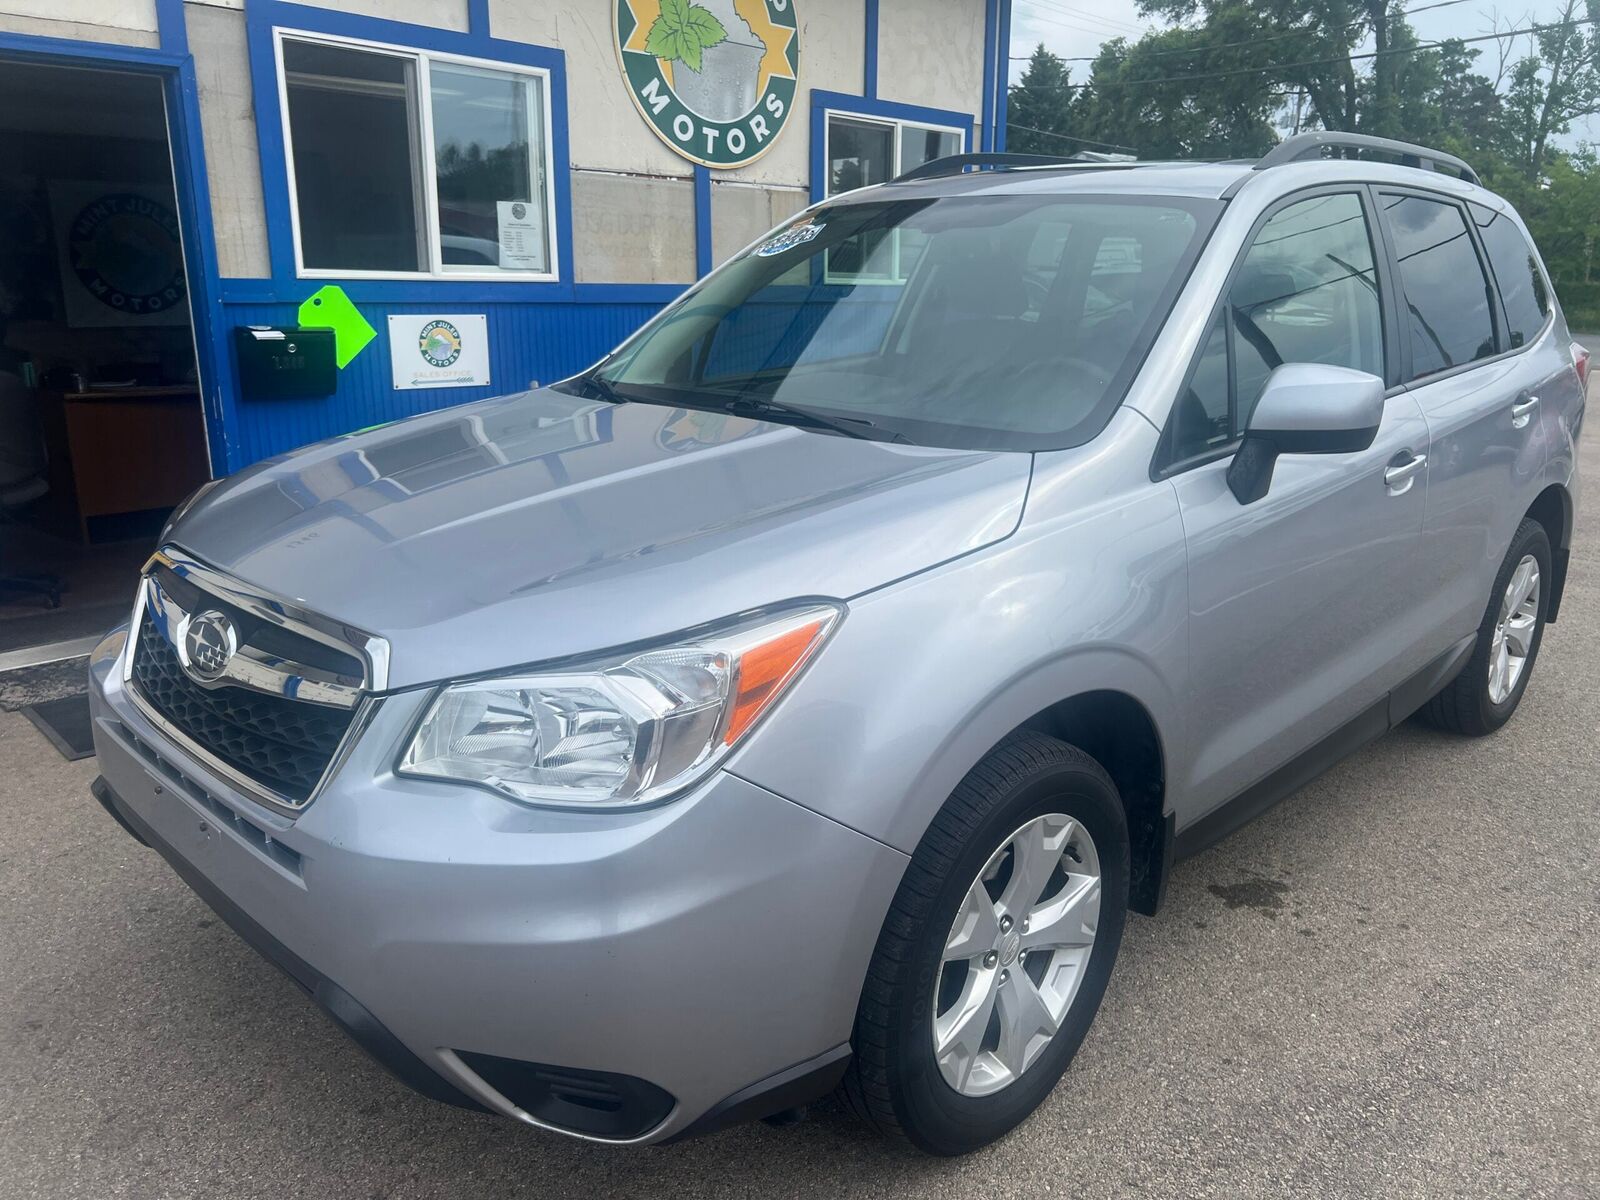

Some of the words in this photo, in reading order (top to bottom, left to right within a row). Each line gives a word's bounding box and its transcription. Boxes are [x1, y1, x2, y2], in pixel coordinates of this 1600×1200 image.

[641, 77, 784, 154] MOTORS
[421, 321, 437, 338] MINT
[438, 321, 458, 338] JULEP
[424, 351, 459, 366] MOTORS
[413, 370, 440, 378] SALES
[442, 369, 472, 377] OFFICE
